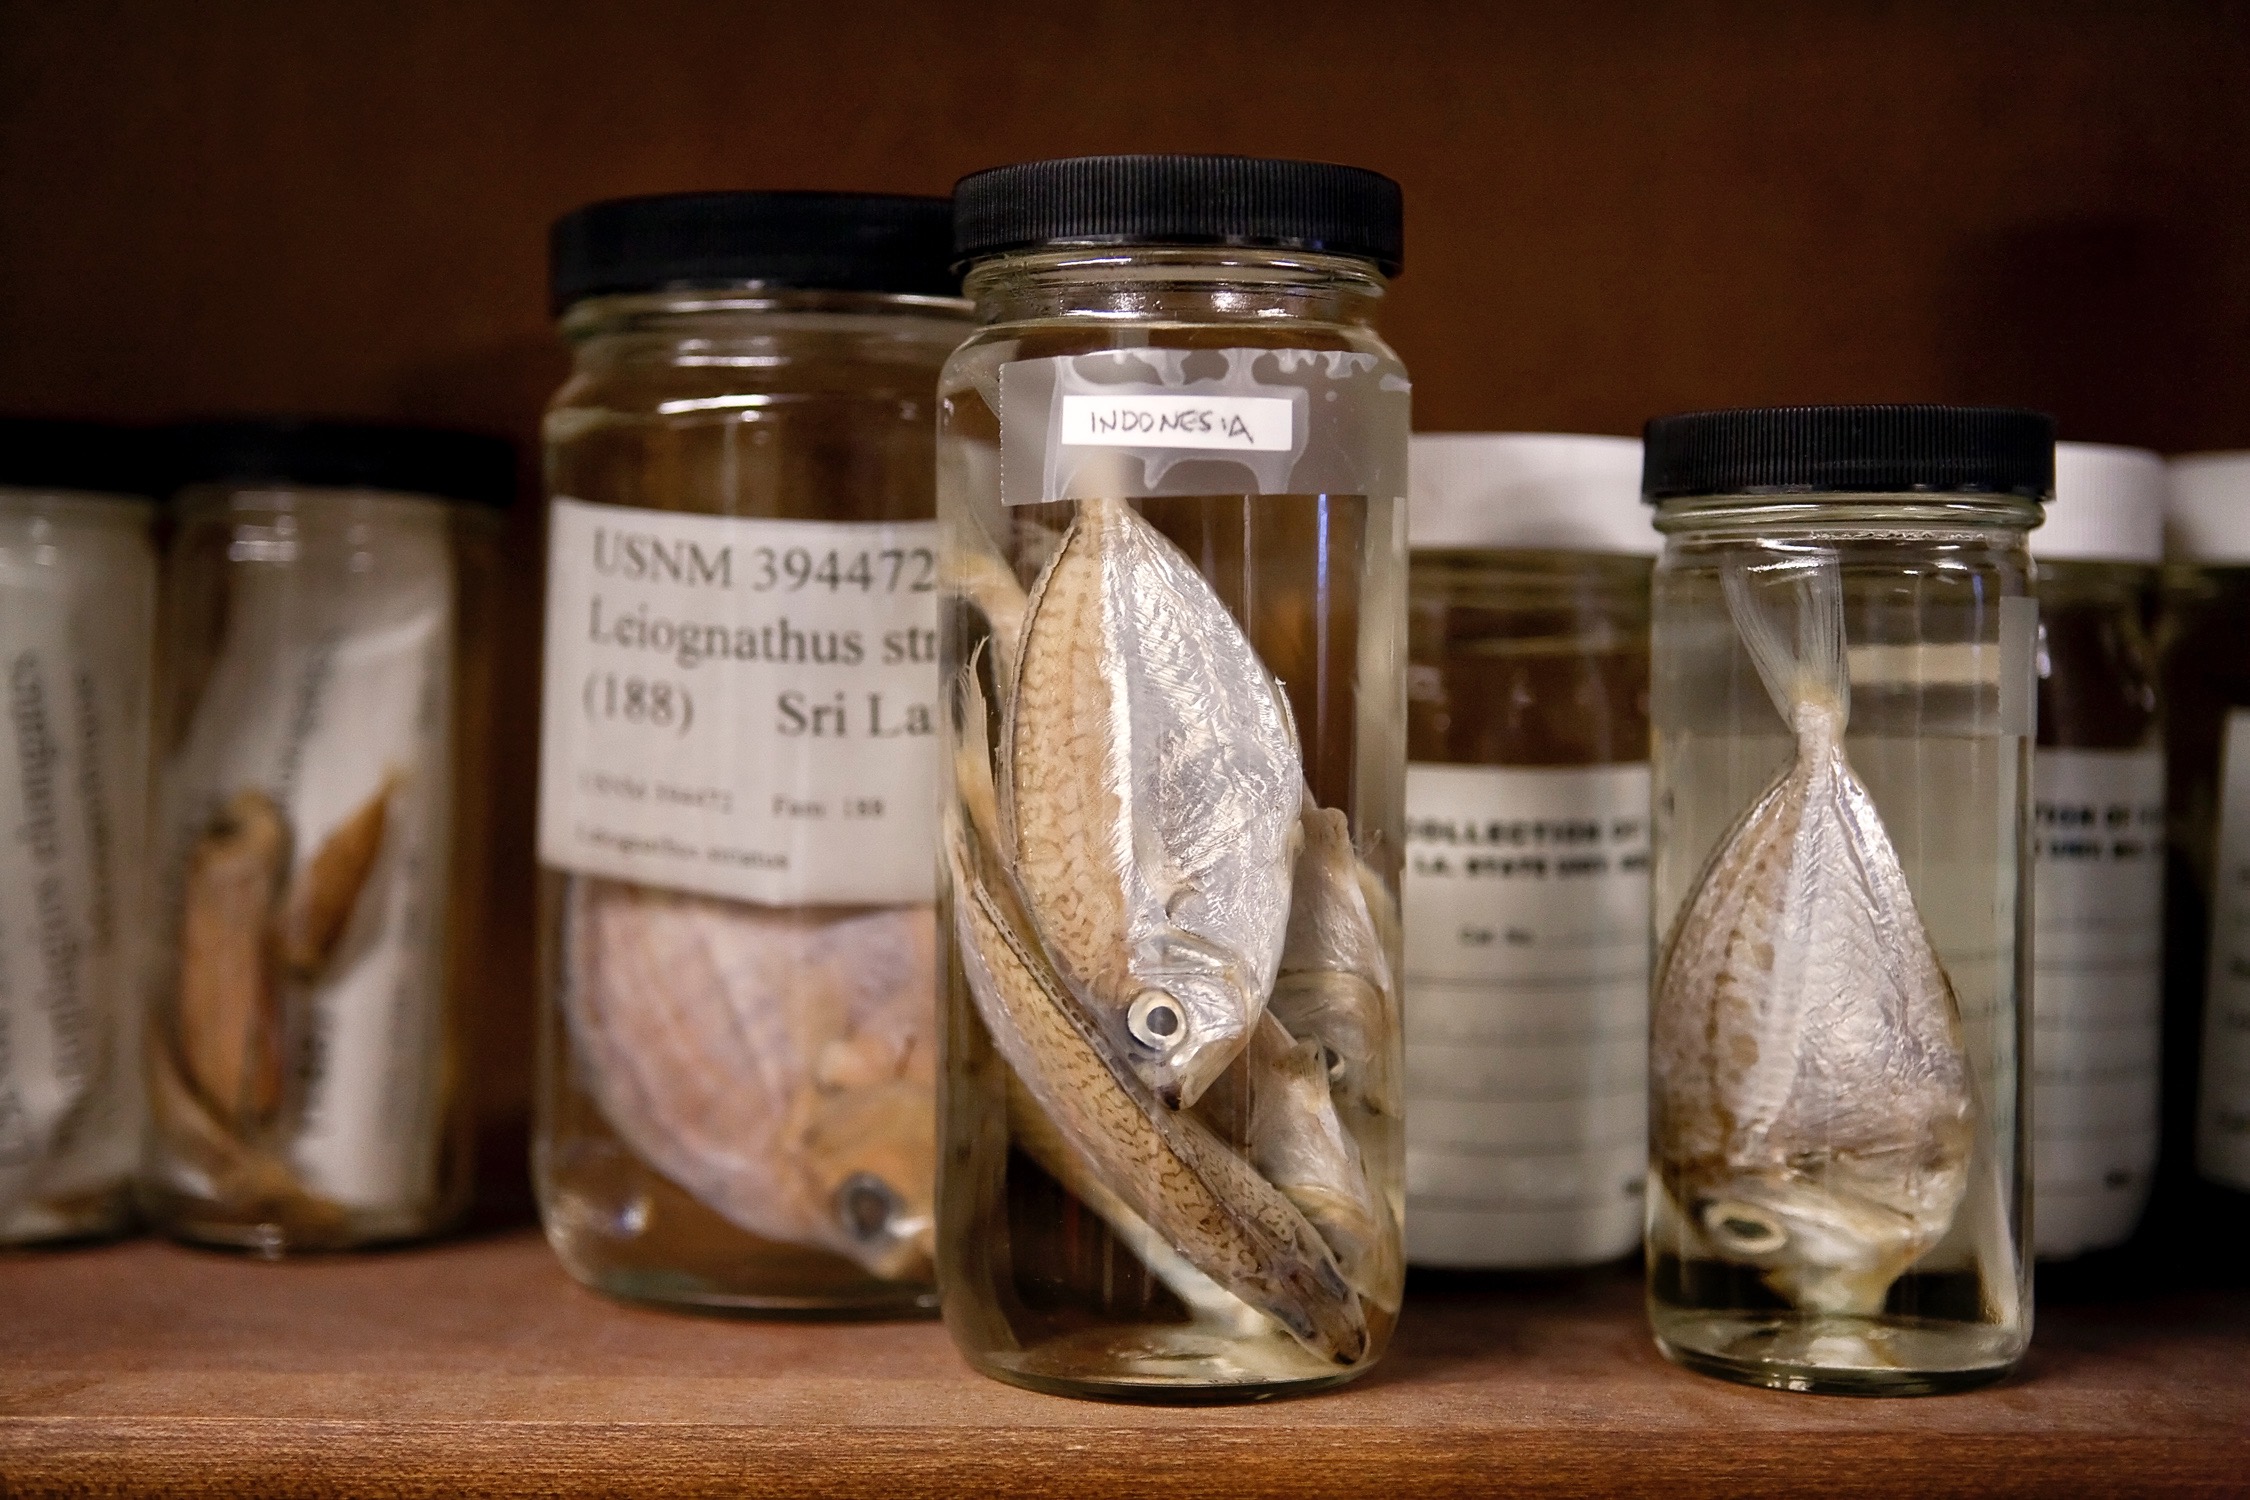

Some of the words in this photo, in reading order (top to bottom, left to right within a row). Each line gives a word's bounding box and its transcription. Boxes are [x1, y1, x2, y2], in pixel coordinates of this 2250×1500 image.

[1090, 409, 1255, 444] INDONESIA
[593, 526, 733, 591] USNM
[752, 545, 936, 594] 394472
[588, 595, 866, 671] Leiognathus
[582, 670, 695, 738] (188)
[776, 690, 848, 738] Sri
